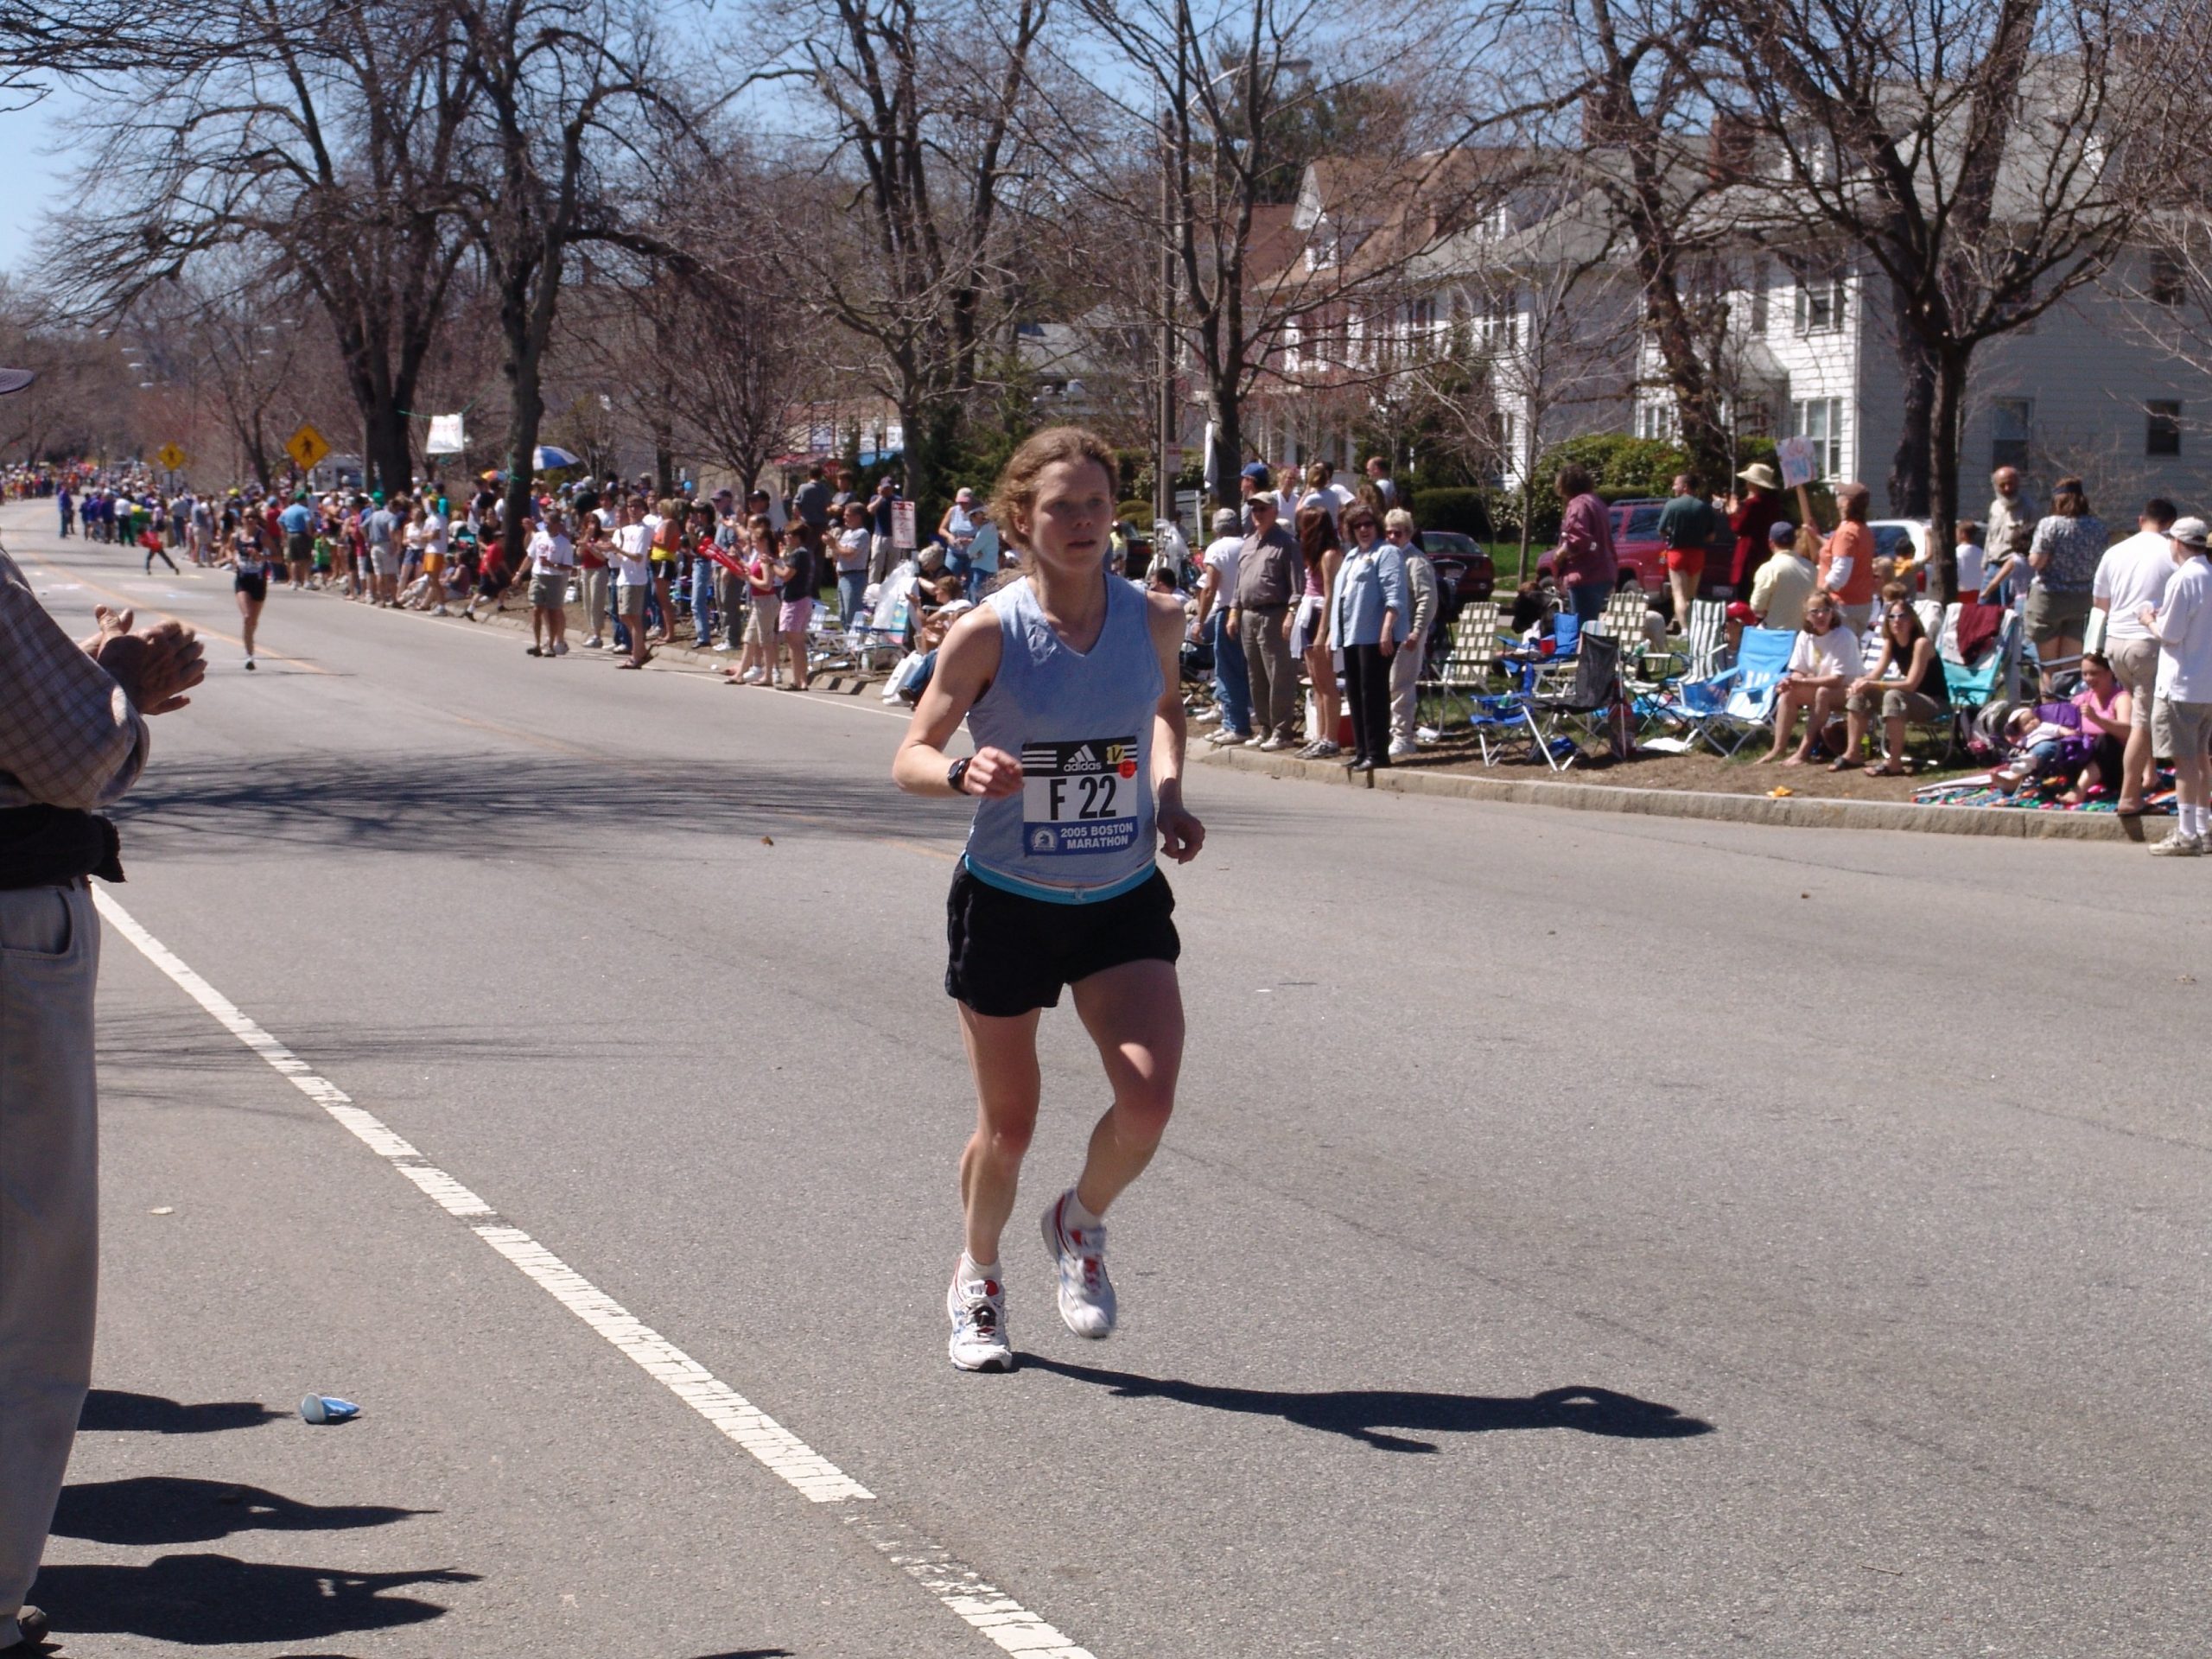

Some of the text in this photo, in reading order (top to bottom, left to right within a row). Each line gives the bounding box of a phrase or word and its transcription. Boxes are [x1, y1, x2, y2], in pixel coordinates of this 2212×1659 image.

[1064, 761, 1102, 772] adidas
[1050, 775, 1116, 820] F 22
[1060, 823, 1134, 838] 2005 BOSTON
[1066, 835, 1128, 849] MARATHON
